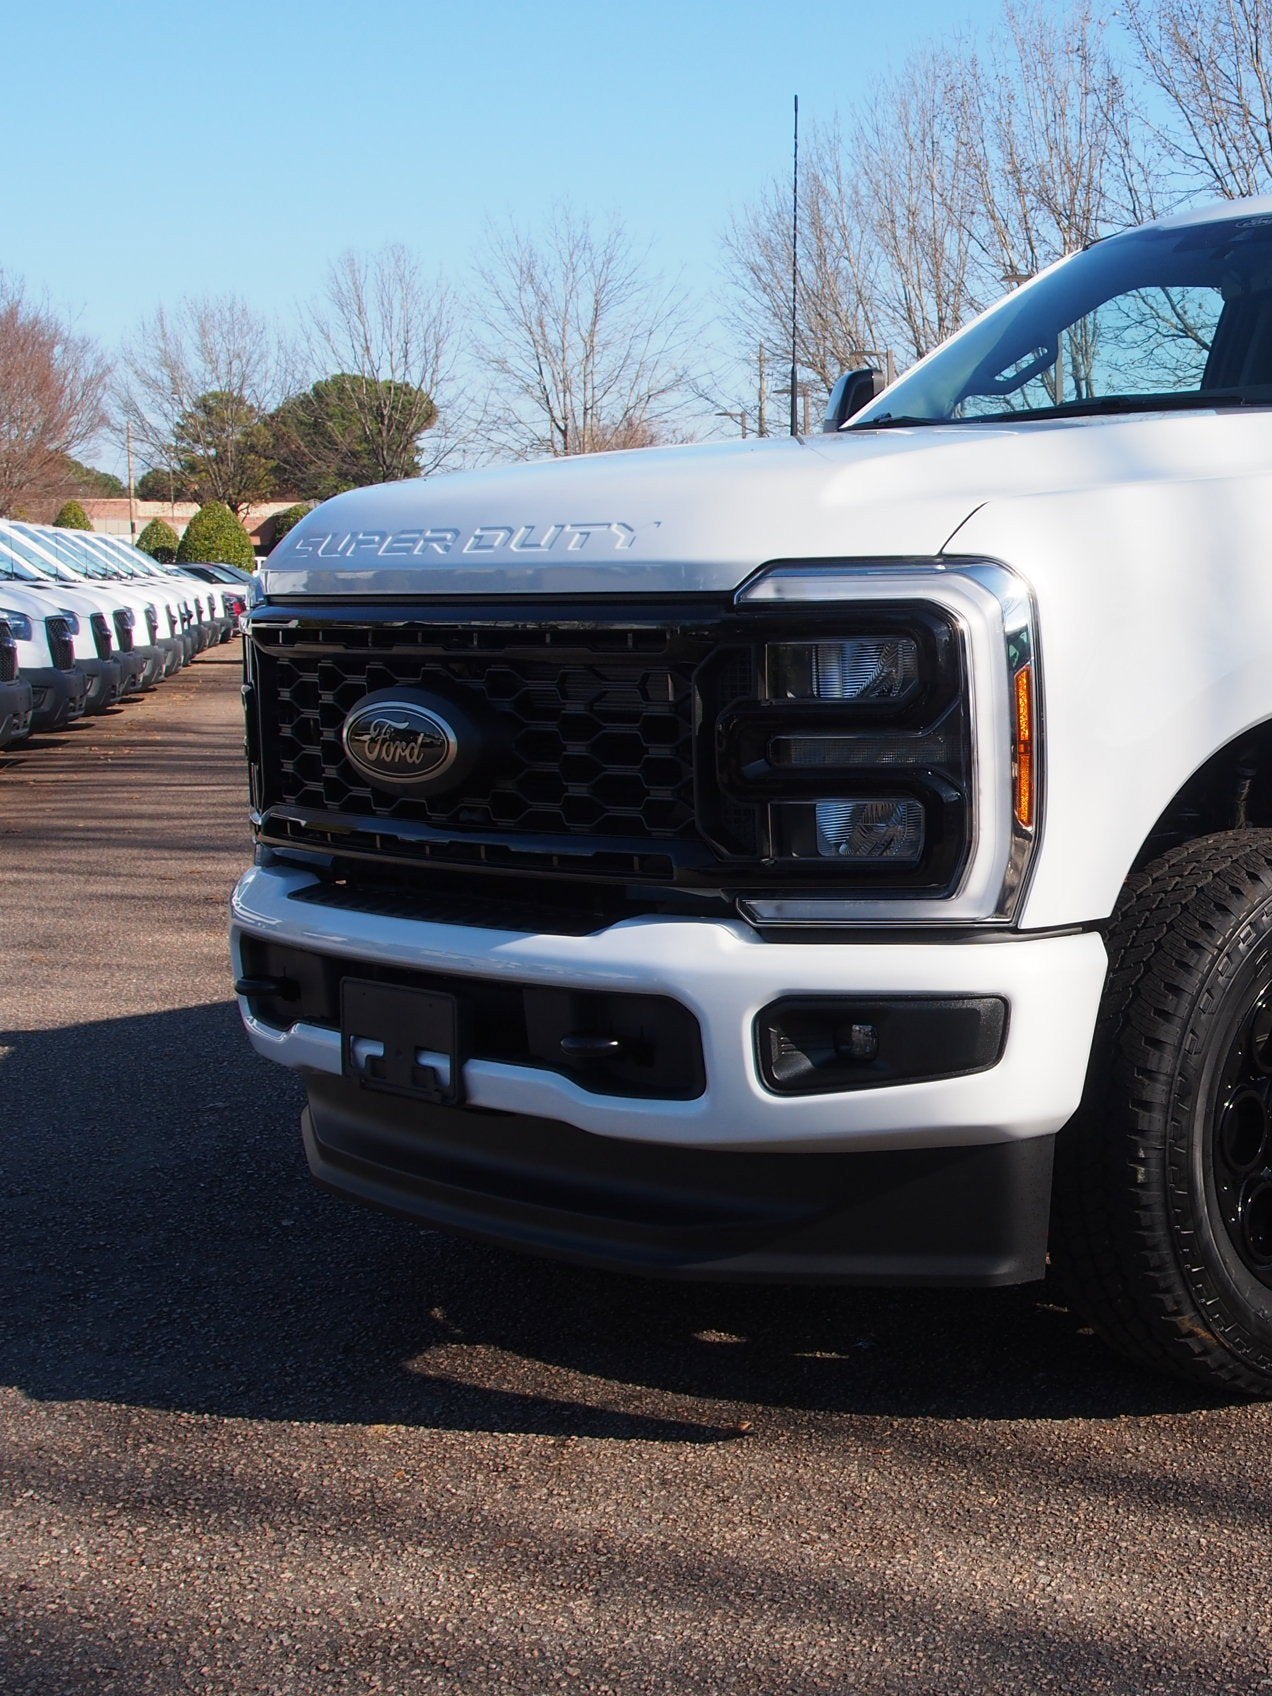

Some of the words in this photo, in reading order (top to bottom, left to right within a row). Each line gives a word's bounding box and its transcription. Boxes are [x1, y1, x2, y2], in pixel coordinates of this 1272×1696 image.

[295, 527, 461, 558] SUPER
[462, 521, 662, 554] DUTY
[357, 718, 425, 764] Ford
